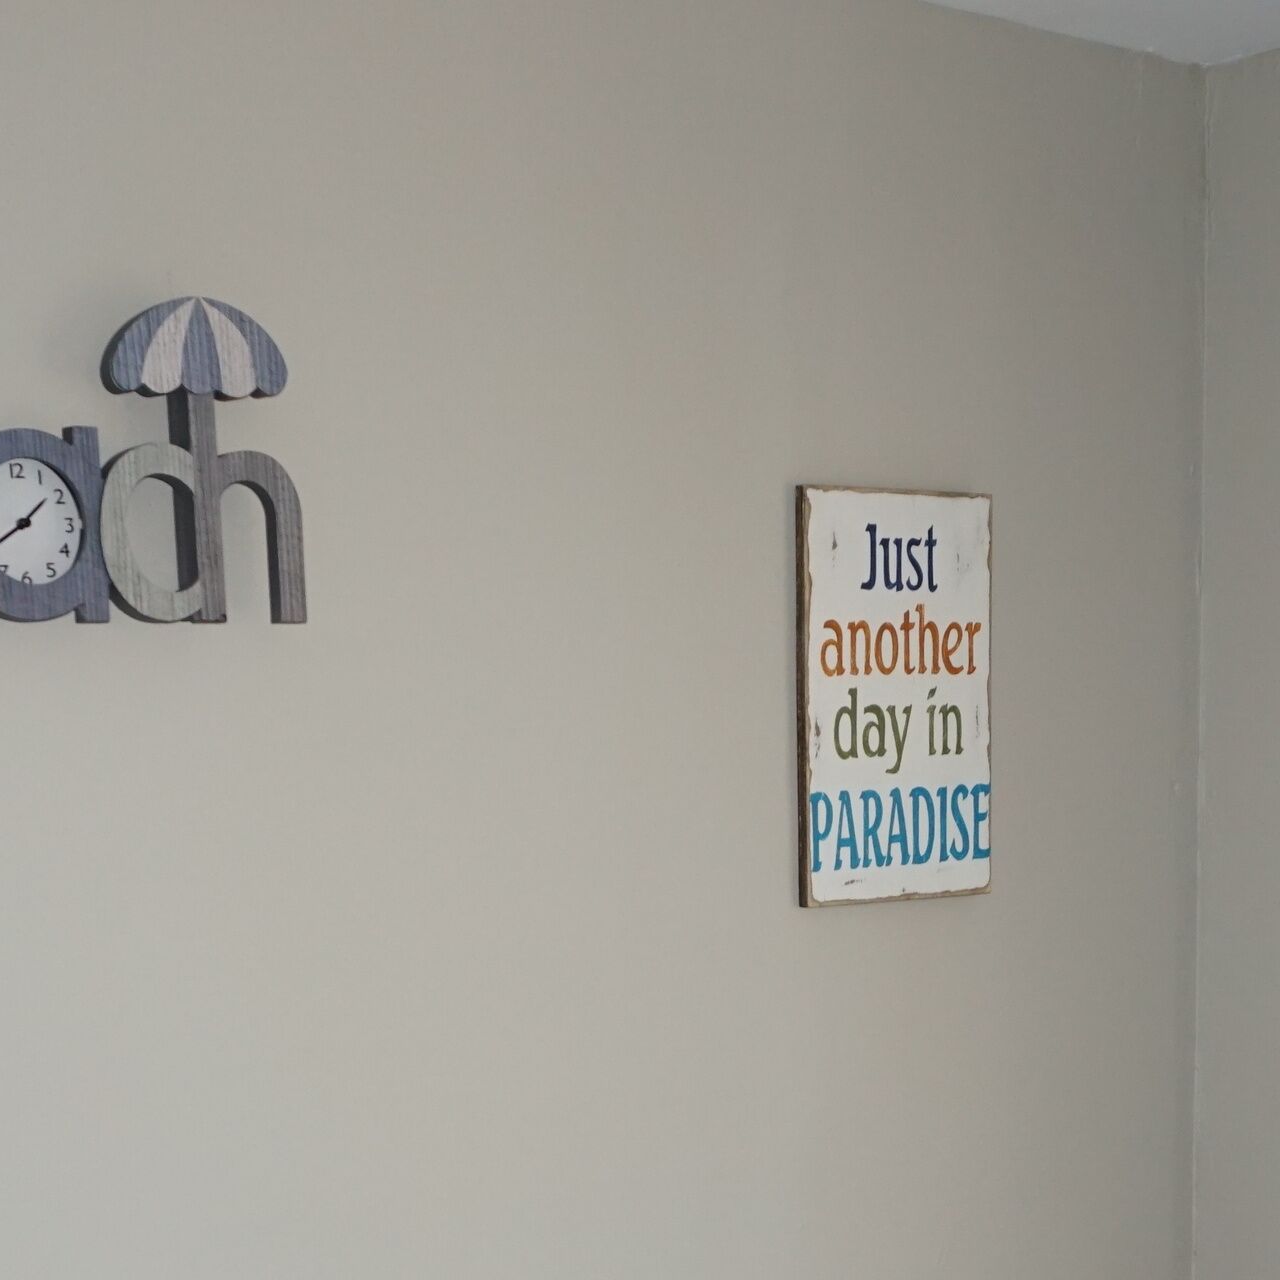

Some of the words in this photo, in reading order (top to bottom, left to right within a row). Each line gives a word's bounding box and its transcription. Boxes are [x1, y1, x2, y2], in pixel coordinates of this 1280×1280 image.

[8, 463, 25, 479] 12
[37, 470, 42, 485] 1
[53, 489, 66, 504] 2
[64, 518, 74, 533] 3
[59, 543, 70, 558] 4
[860, 523, 938, 593] Just
[46, 562, 56, 578] 5
[820, 603, 981, 677] another
[834, 687, 912, 774] day
[927, 686, 964, 755] in
[809, 784, 991, 873] PARADISE
